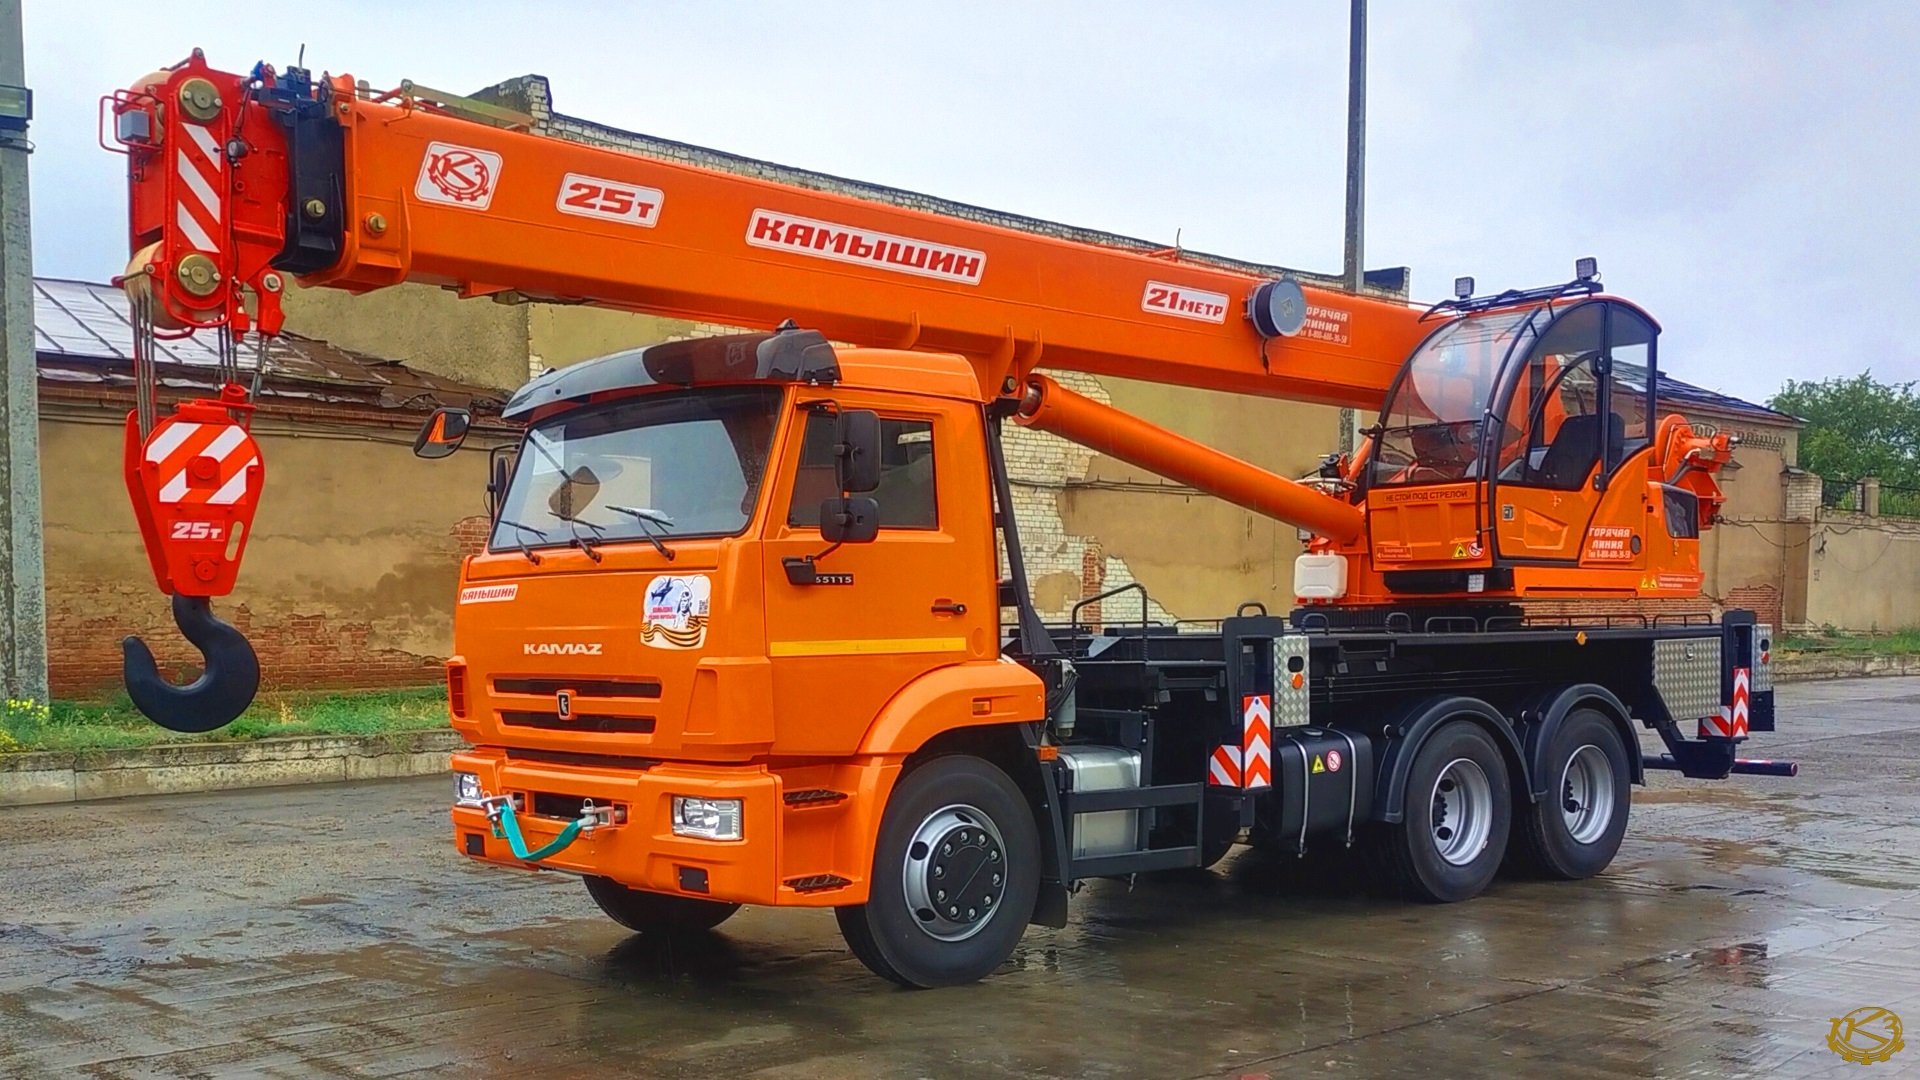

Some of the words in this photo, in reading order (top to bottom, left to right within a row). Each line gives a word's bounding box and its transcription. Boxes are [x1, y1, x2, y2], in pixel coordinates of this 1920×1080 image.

[753, 217, 980, 277] КАМЫШИН
[1305, 306, 1348, 323] ОРЯЧАЯ
[1303, 318, 1341, 334] ЛИНИЯ
[1412, 492, 1429, 501] ПОД
[1589, 527, 1630, 538] ГОРЯЧАЯ
[1592, 539, 1624, 550] ЛИНИЯ
[461, 587, 516, 601] КАМЫШИН
[523, 643, 603, 655] KAMAZ
